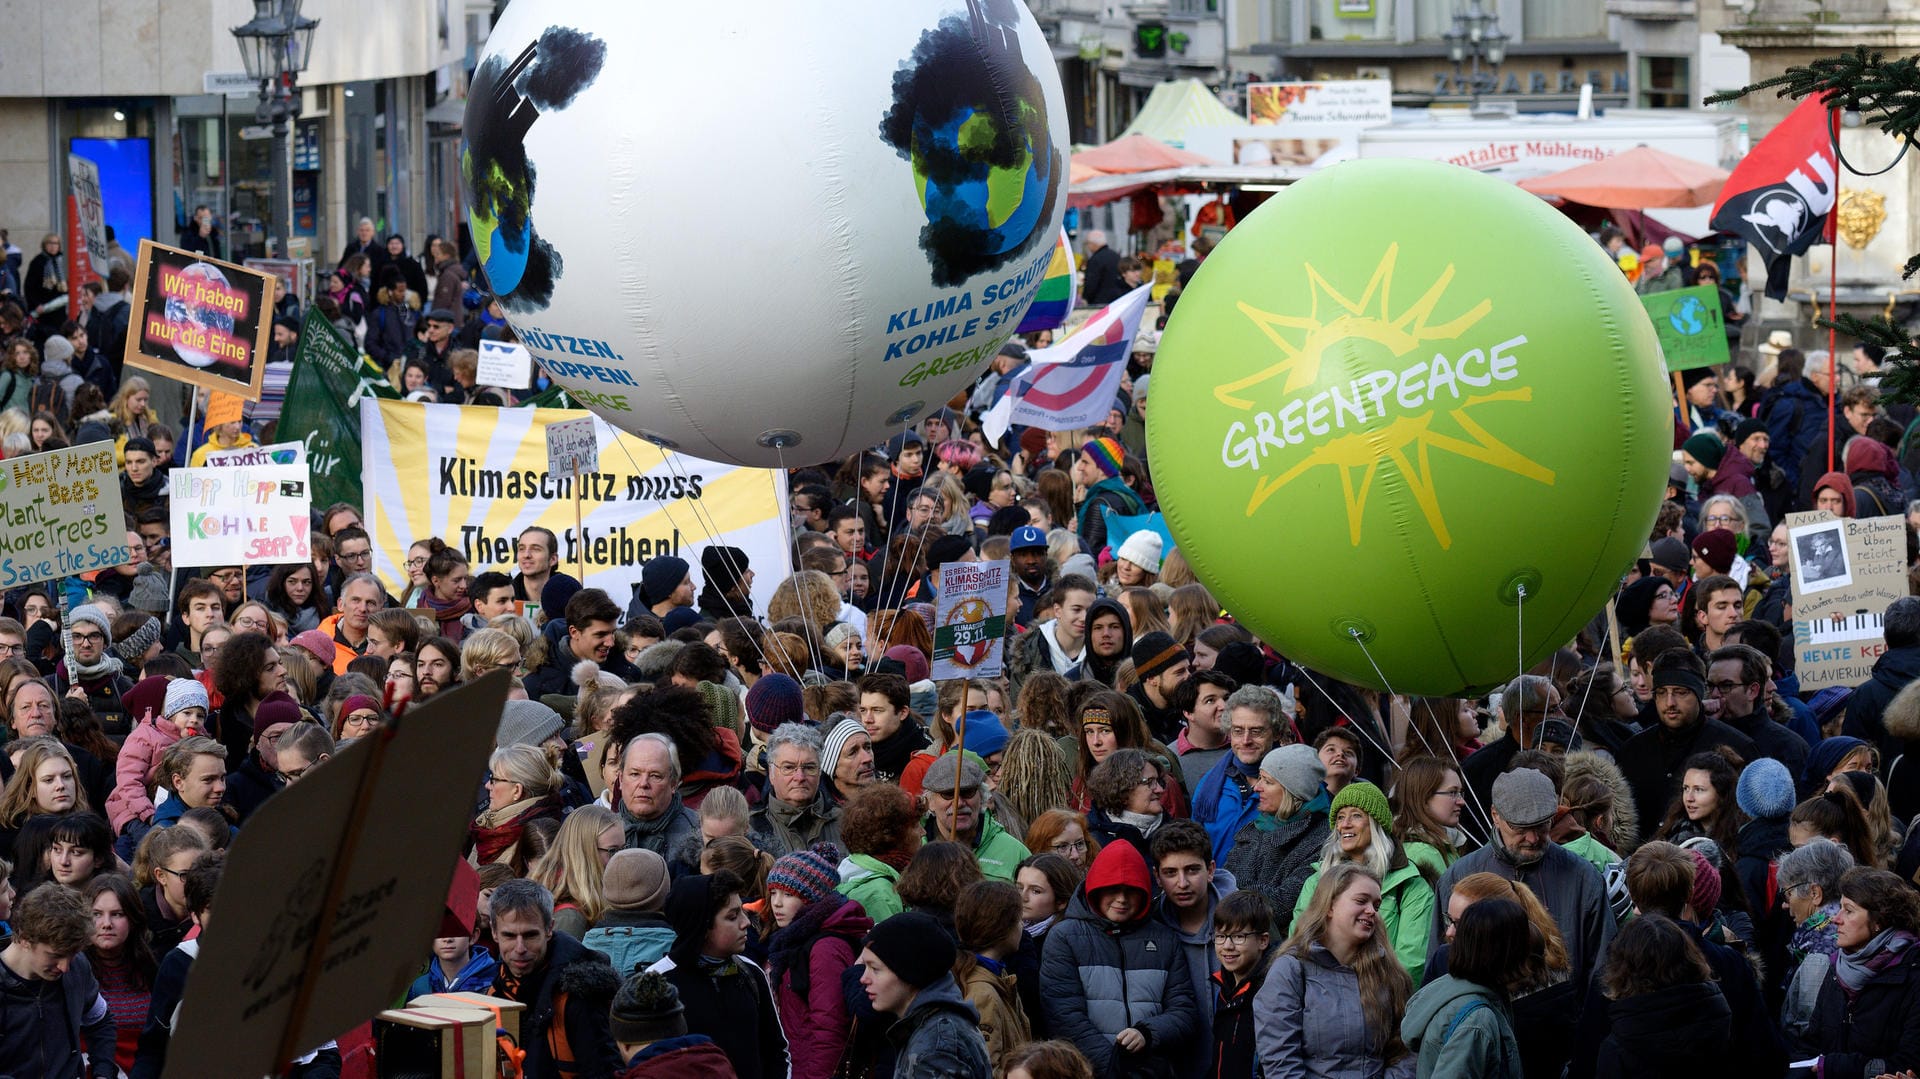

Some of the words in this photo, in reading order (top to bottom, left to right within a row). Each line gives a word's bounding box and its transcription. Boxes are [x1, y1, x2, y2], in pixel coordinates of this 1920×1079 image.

[164, 273, 192, 297] Wir
[195, 282, 244, 314] haben
[886, 292, 973, 334] KLIMA
[150, 321, 178, 341] nur
[181, 328, 206, 349] die
[210, 334, 246, 361] Eine
[511, 323, 624, 361] CHÜTZEN.
[883, 317, 980, 362] KOHLE
[535, 355, 639, 387] TOPPEN!
[1222, 334, 1528, 470] GREENPEACE
[626, 474, 704, 501] muss
[1794, 511, 1830, 526] NUR
[1847, 522, 1902, 537] Beethoven
[564, 526, 680, 566] bleiben!
[1857, 548, 1897, 561] reicht
[2, 558, 54, 586] Save
[56, 546, 85, 574] the
[88, 544, 130, 568] Seas
[945, 569, 953, 577] ES
[953, 566, 979, 576] REICHT!
[1858, 560, 1904, 576] nicht!
[945, 567, 1002, 588] KLIMASCHUTZ
[945, 585, 962, 595] JETZT
[963, 583, 978, 592] UND
[953, 628, 987, 646] 29.11.
[1803, 647, 1853, 663] HEUTE
[1800, 664, 1875, 683] KLAVIERUN
